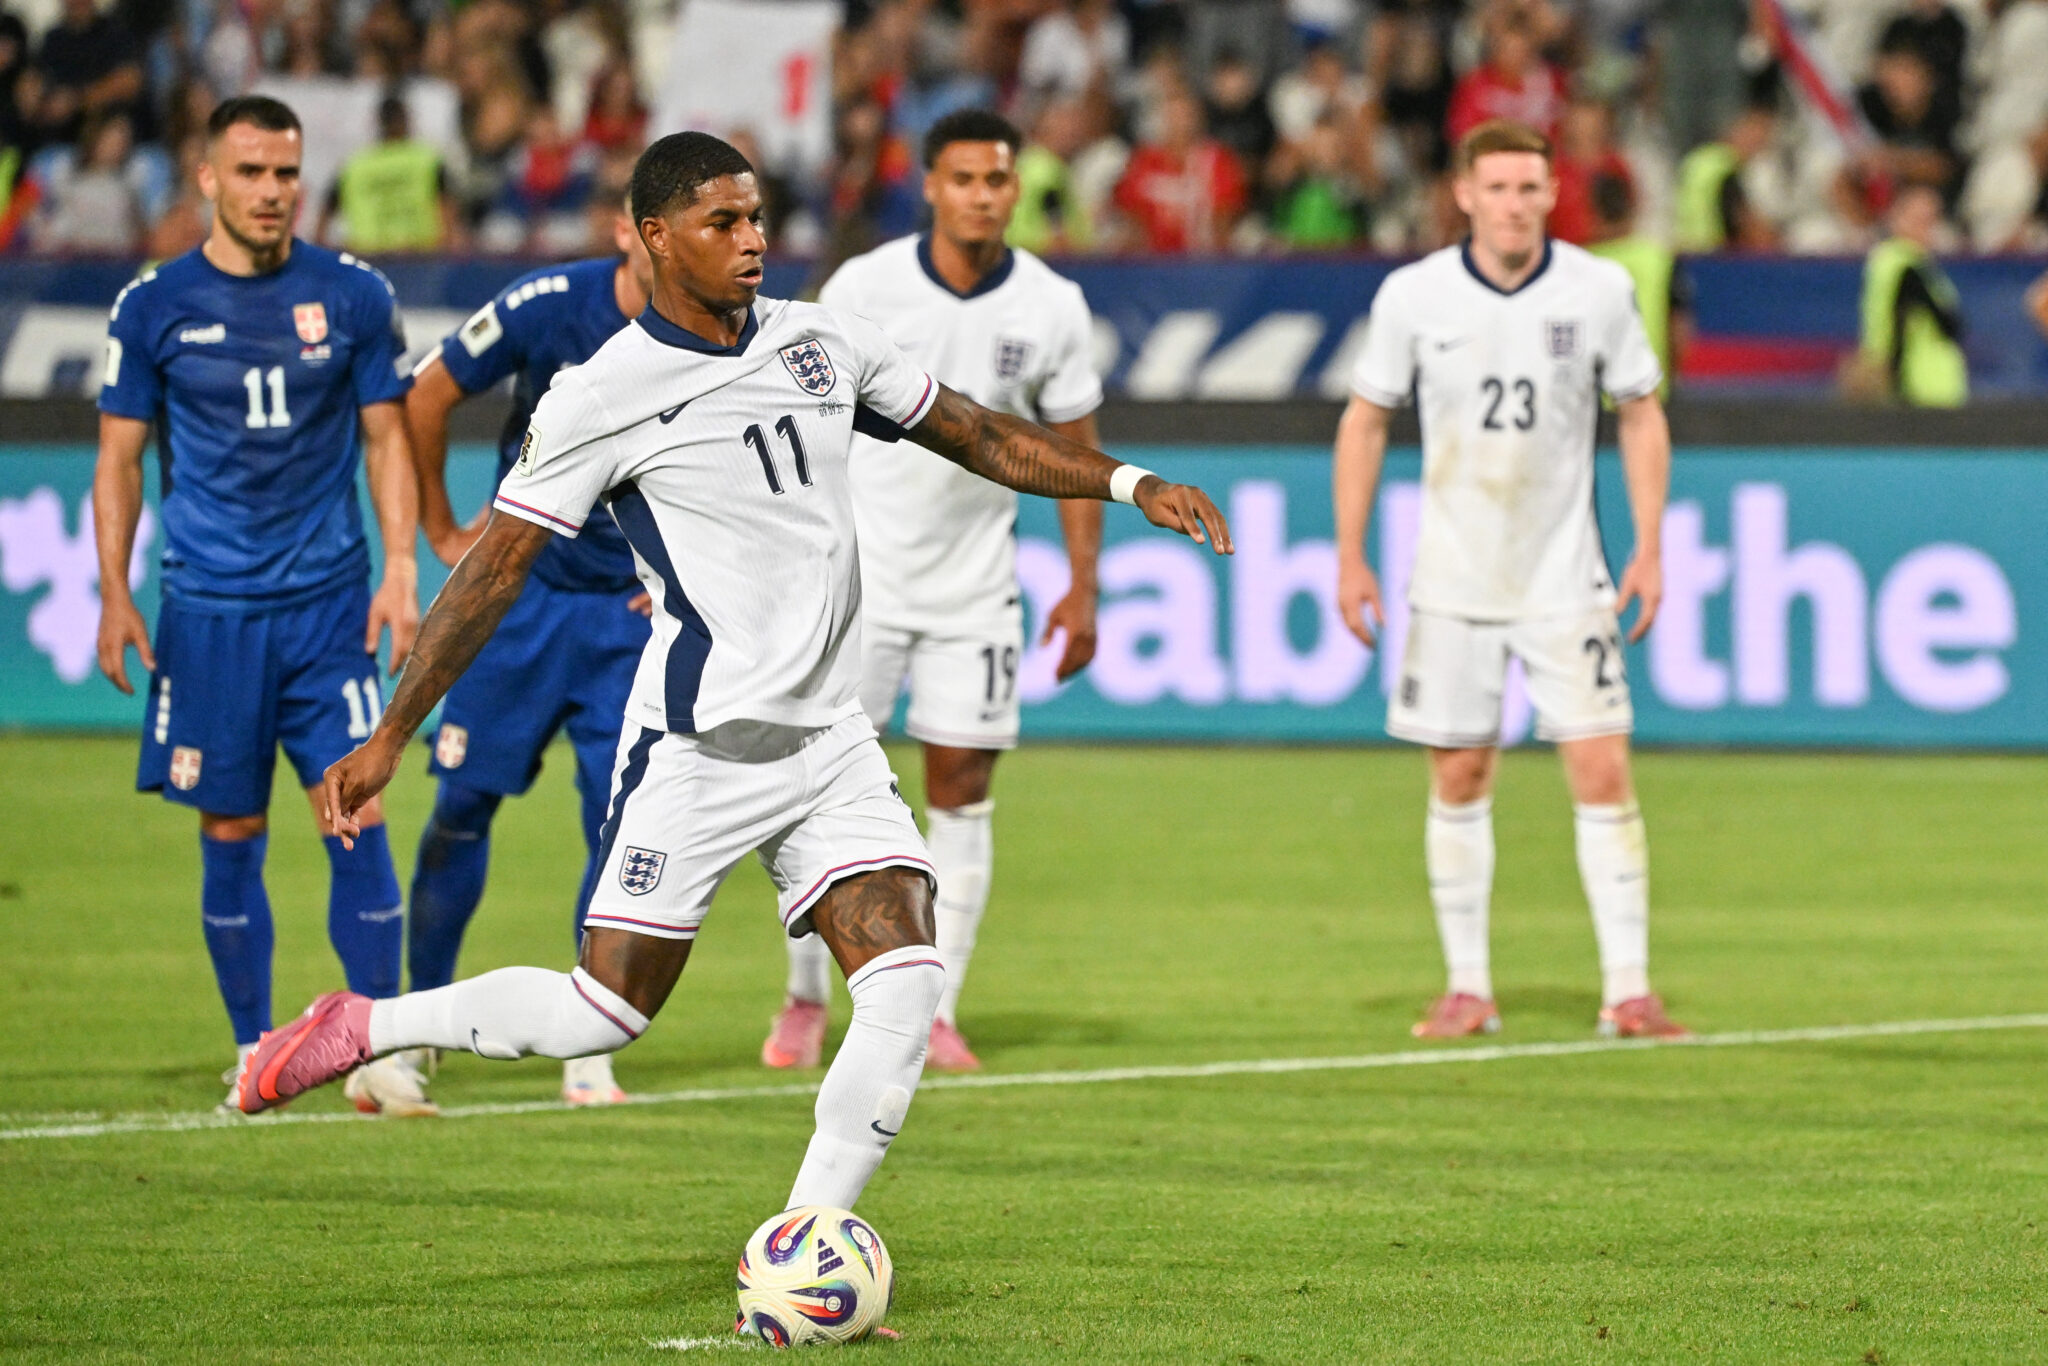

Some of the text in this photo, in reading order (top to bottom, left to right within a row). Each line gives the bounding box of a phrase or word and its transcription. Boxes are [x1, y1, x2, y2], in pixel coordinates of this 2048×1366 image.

[243, 365, 291, 428] 11
[1481, 376, 1535, 432] 23
[743, 414, 813, 495] 11
[1648, 481, 2018, 714] the
[980, 645, 1019, 702] 19
